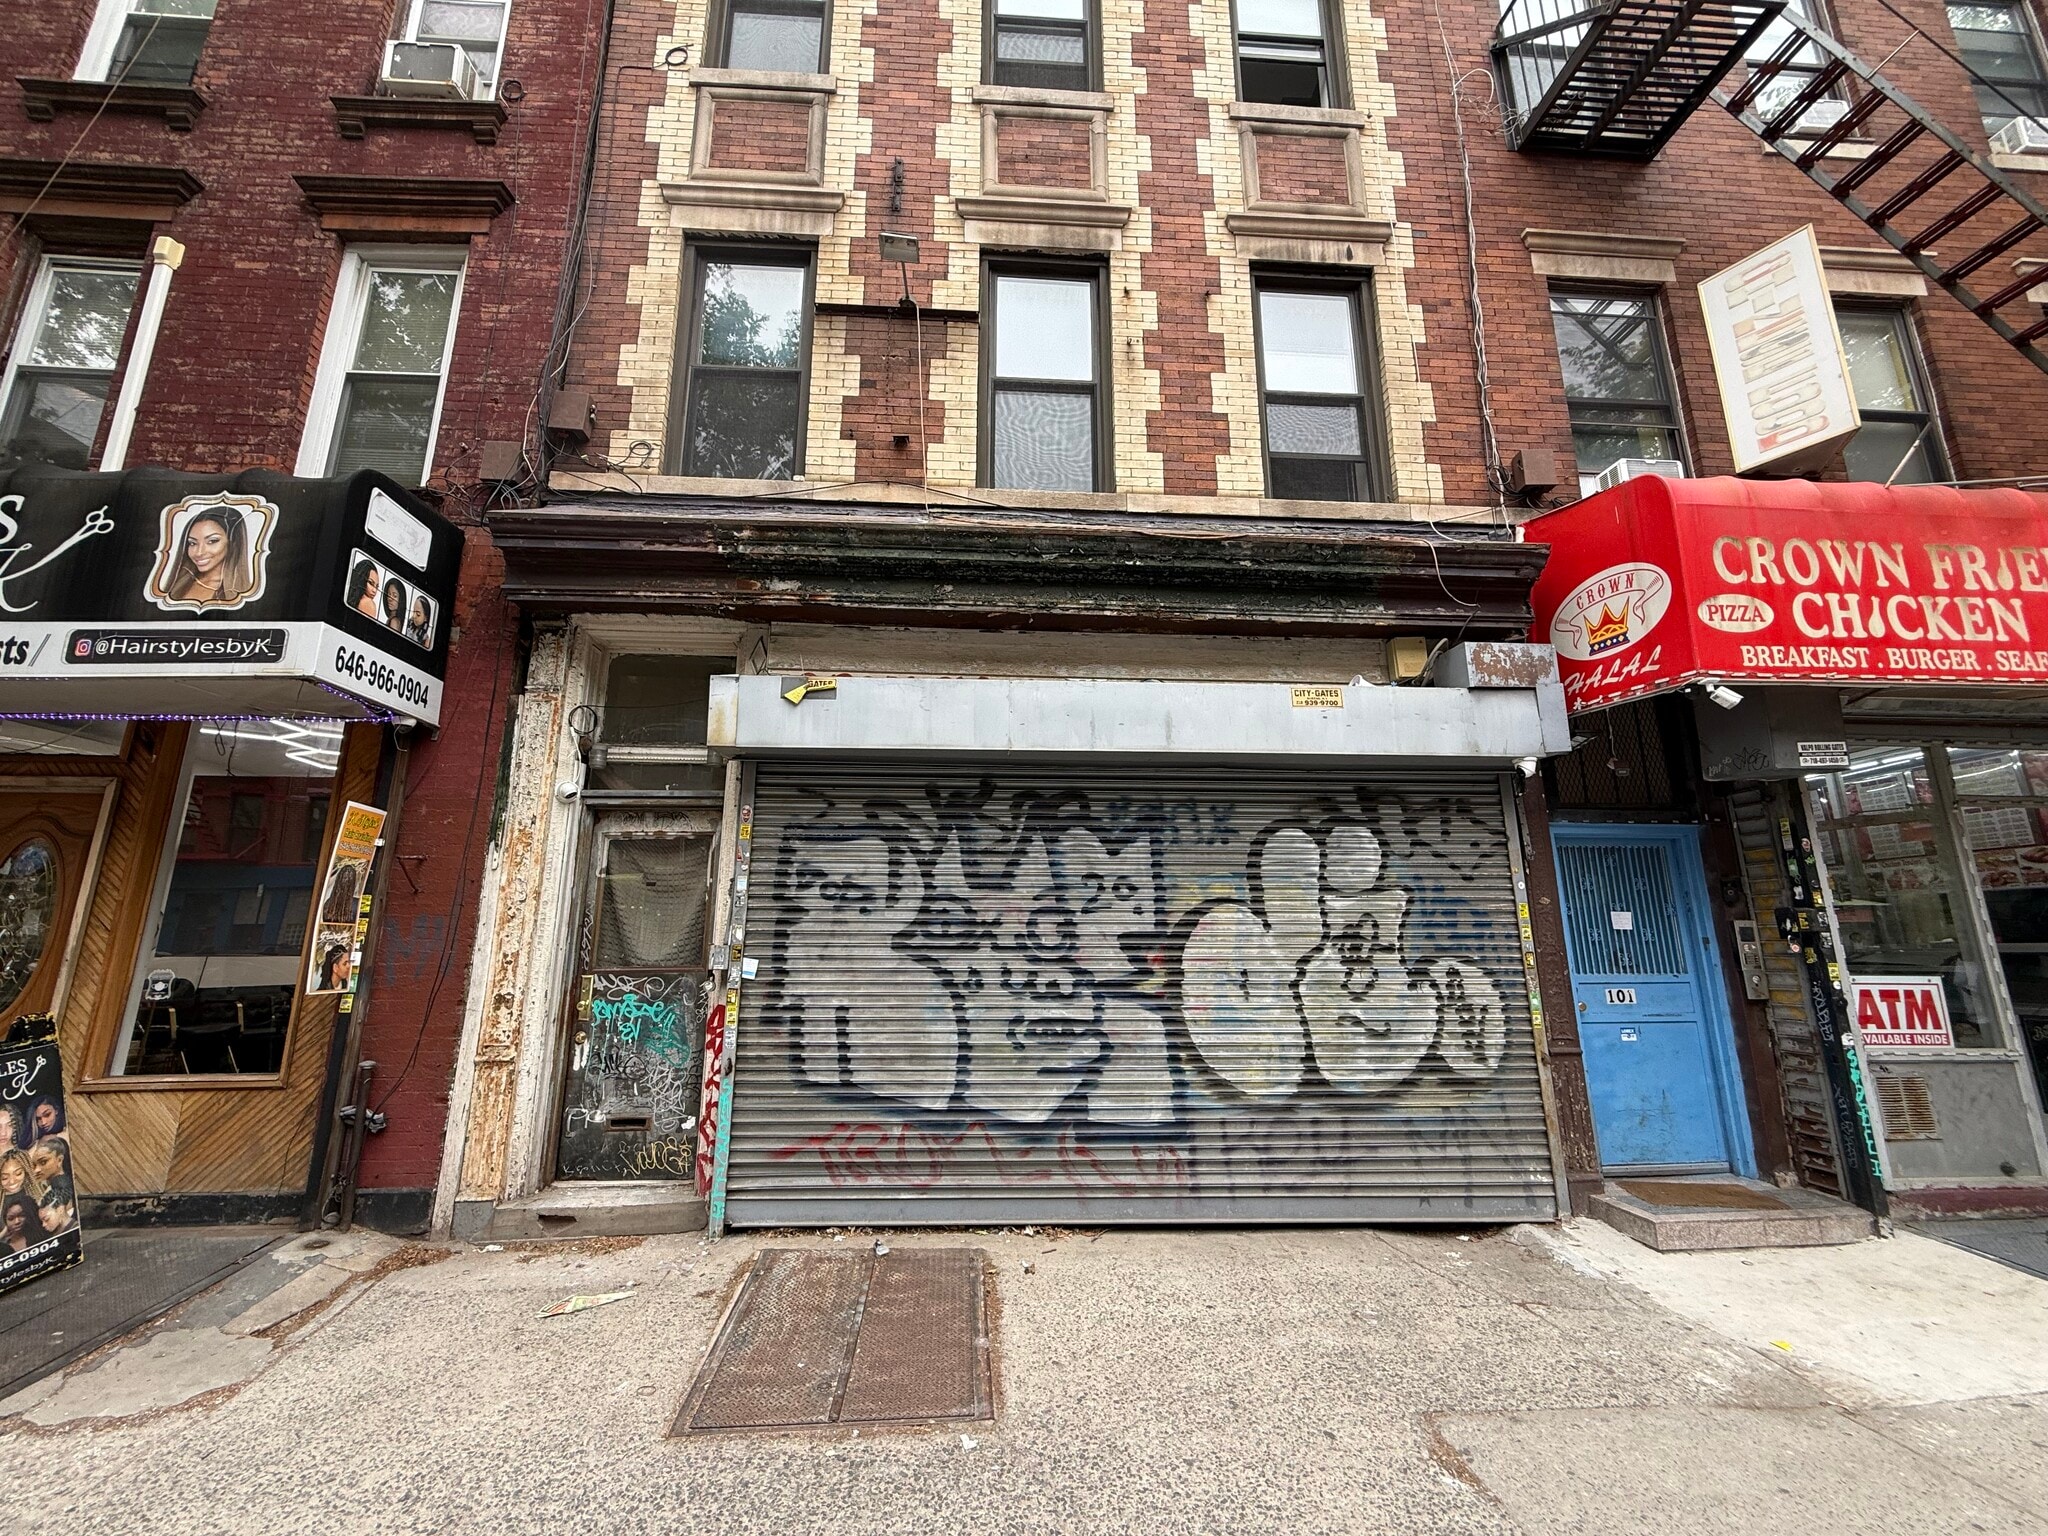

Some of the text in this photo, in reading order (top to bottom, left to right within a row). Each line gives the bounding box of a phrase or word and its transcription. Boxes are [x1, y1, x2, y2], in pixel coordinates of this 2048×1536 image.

[1713, 535, 2048, 592] CROWN FRIE
[1576, 573, 1635, 610] CROWN
[1706, 604, 1766, 622] PIZZA
[1792, 592, 2030, 642] CHICKEN
[335, 645, 429, 708] 646-966-0904
[1564, 645, 1662, 695] HALAL
[1740, 645, 1870, 669] BREAKFAST
[1885, 648, 1981, 671] BURGER
[1608, 989, 1634, 1003] 101
[1858, 989, 1943, 1030] ATM
[1861, 1034, 1948, 1045] VAILABLE INSIDE
